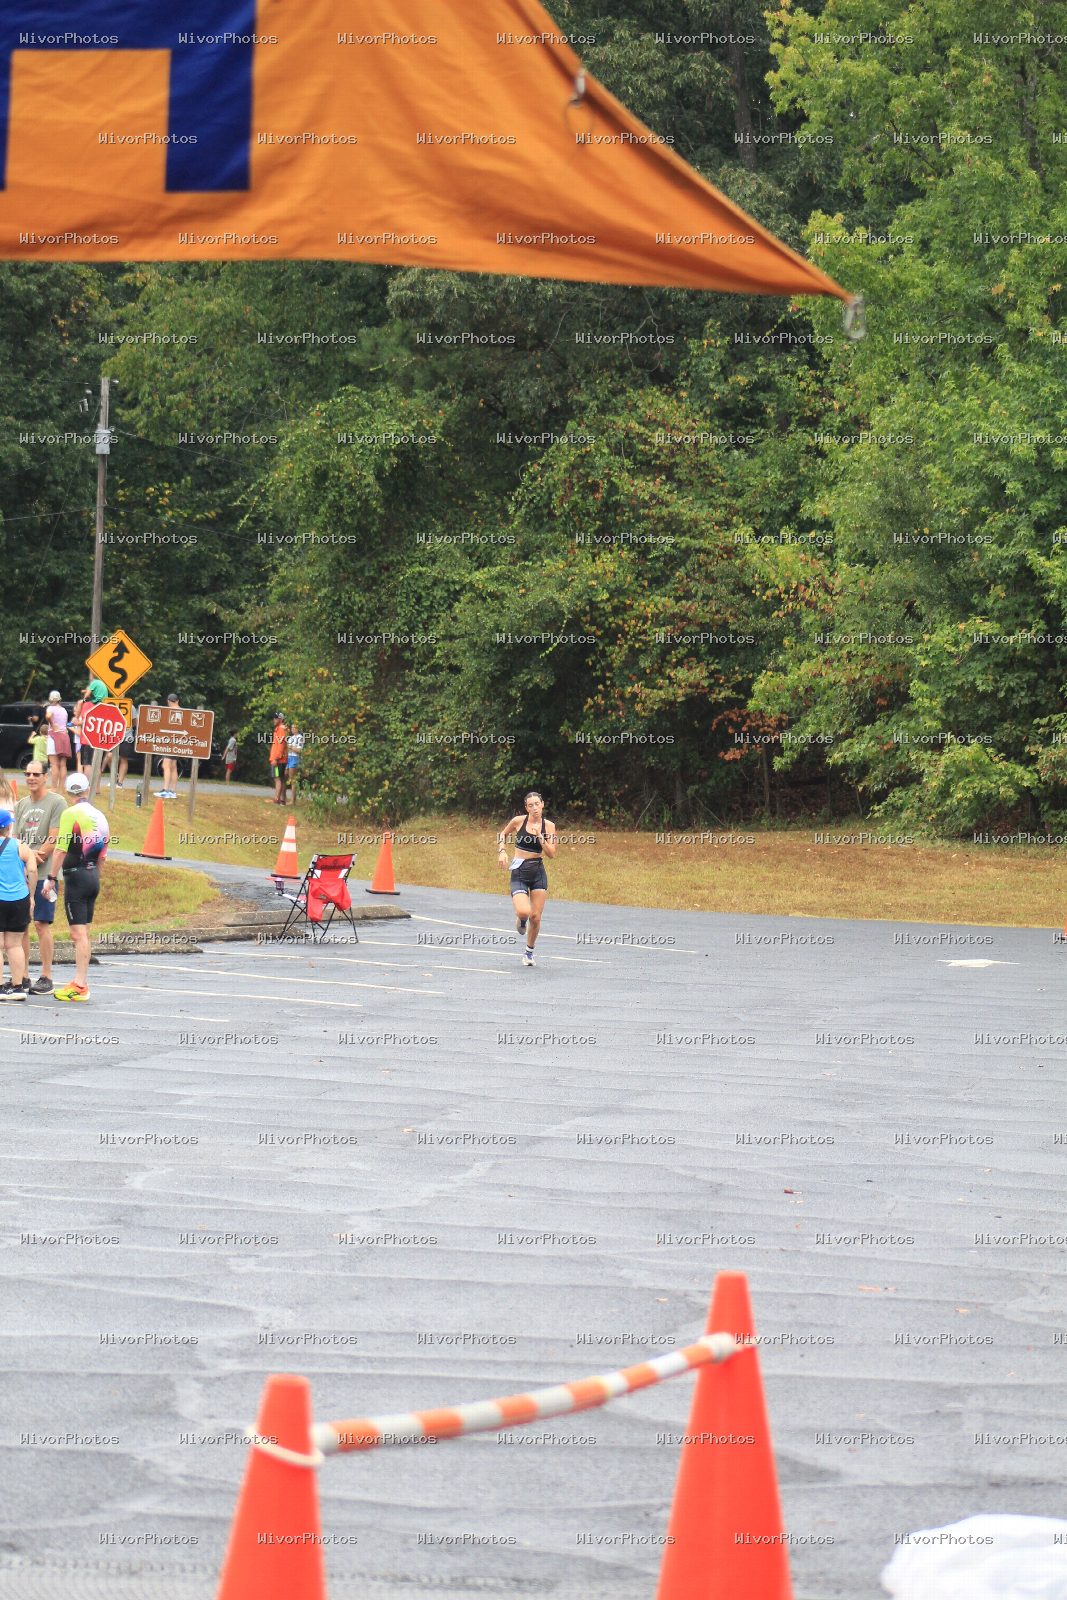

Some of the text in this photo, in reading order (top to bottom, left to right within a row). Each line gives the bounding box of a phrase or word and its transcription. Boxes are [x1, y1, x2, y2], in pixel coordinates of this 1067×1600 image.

[86, 716, 123, 737] STOP
[152, 744, 193, 755] Tennis Courts
